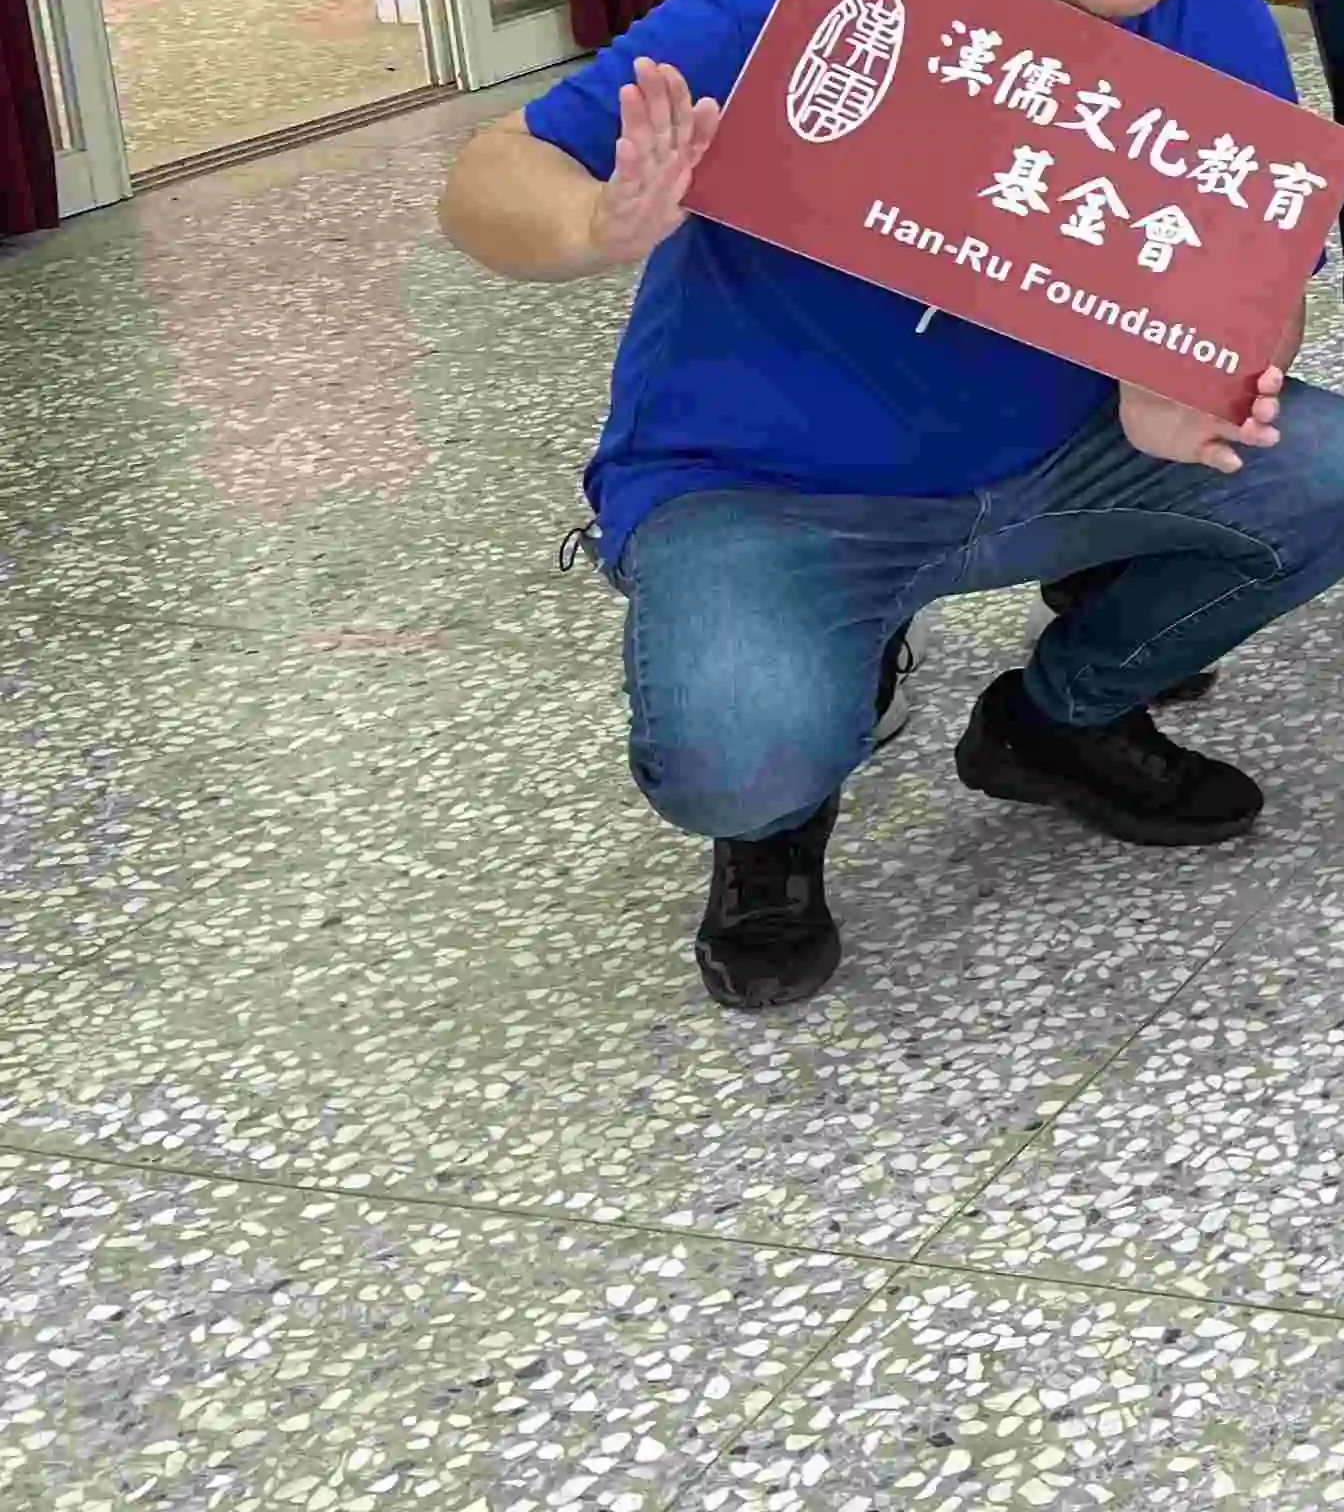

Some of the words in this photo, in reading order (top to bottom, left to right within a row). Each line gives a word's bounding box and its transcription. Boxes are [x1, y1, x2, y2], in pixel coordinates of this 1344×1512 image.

[927, 19, 1328, 232] 漢儒文化教育
[979, 145, 1201, 273] 基金會
[864, 199, 1013, 281] Han-Ru
[1020, 266, 1241, 375] Foundation
